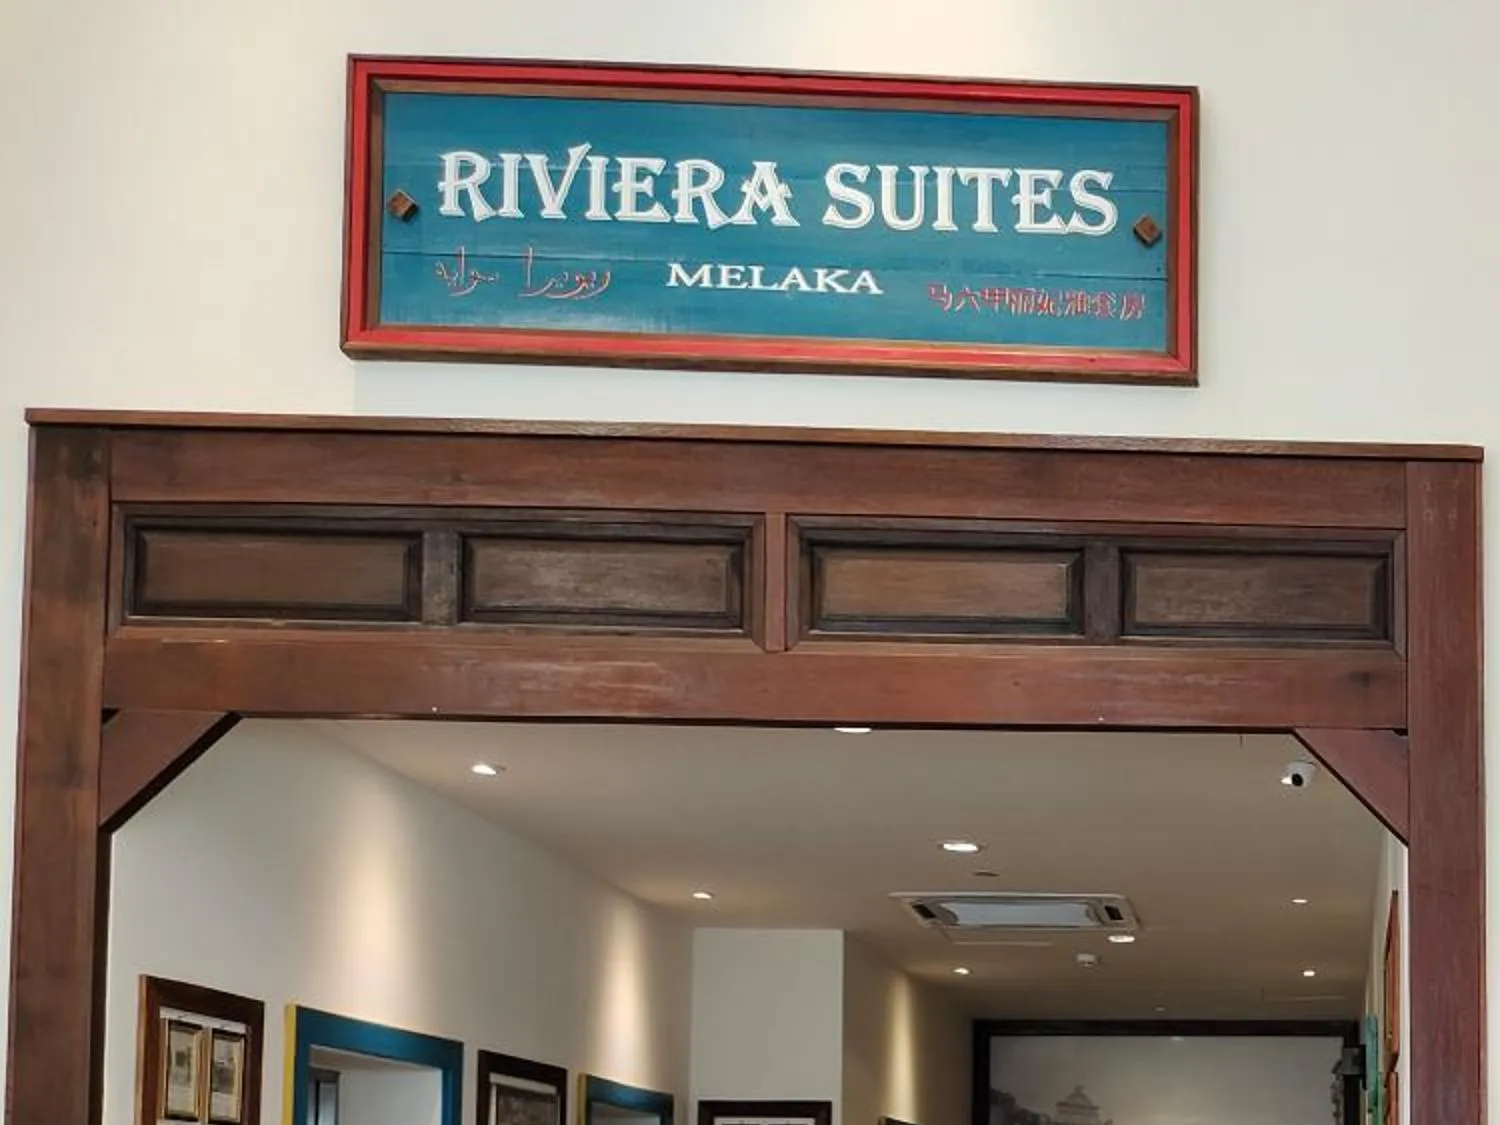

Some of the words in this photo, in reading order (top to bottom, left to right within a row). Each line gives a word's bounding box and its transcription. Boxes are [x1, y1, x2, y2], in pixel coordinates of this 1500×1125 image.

[437, 141, 801, 230] RIVIERA
[822, 162, 1120, 236] SUITES
[665, 262, 884, 295] MELAKA
